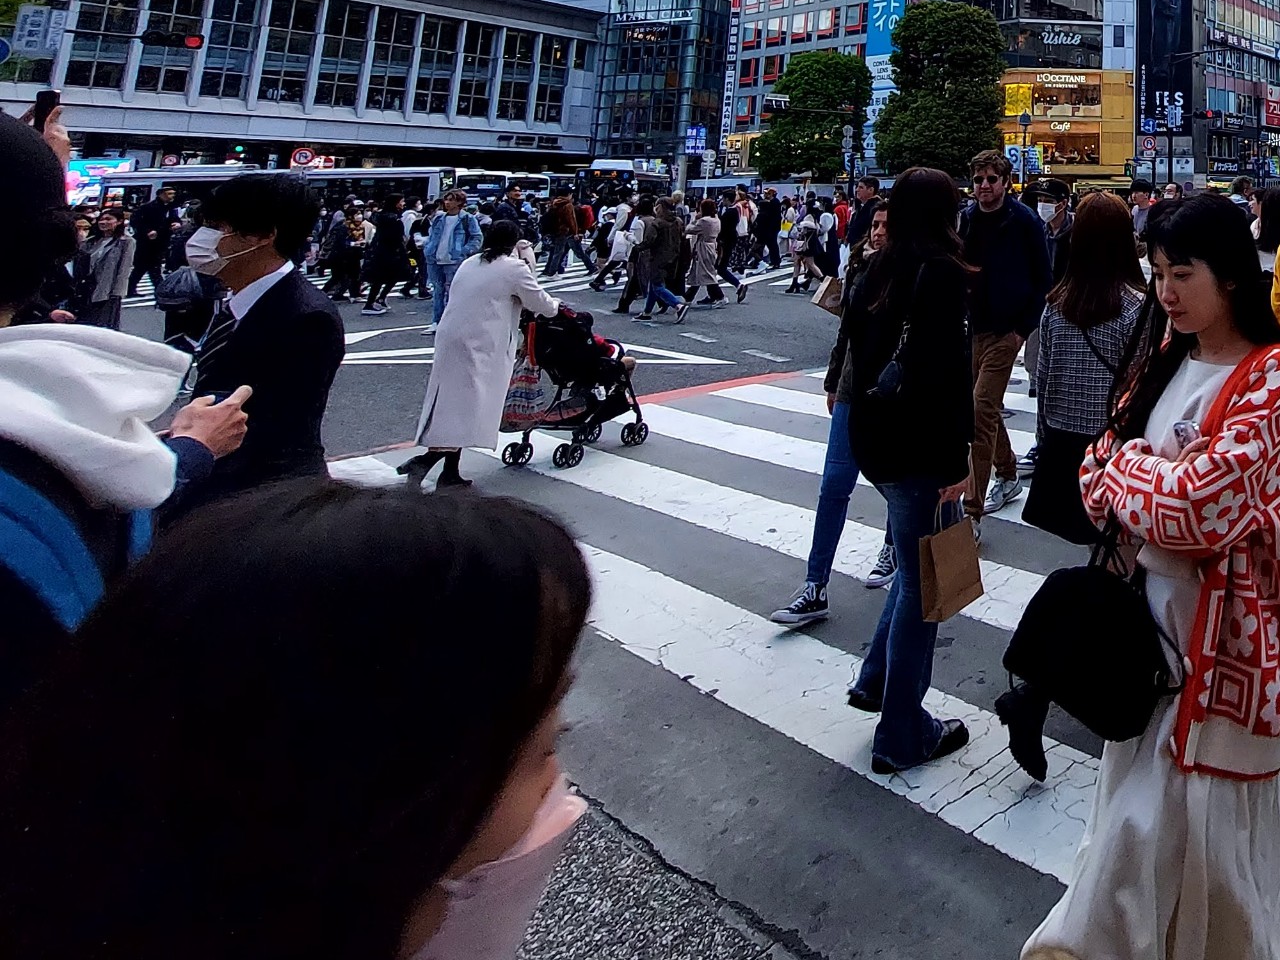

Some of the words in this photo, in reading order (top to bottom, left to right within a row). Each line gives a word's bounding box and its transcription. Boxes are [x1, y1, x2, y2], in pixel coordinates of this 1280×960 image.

[661, 10, 693, 18] CITY
[1036, 73, 1086, 82] L'OCCITANE
[1051, 121, 1071, 132] Café
